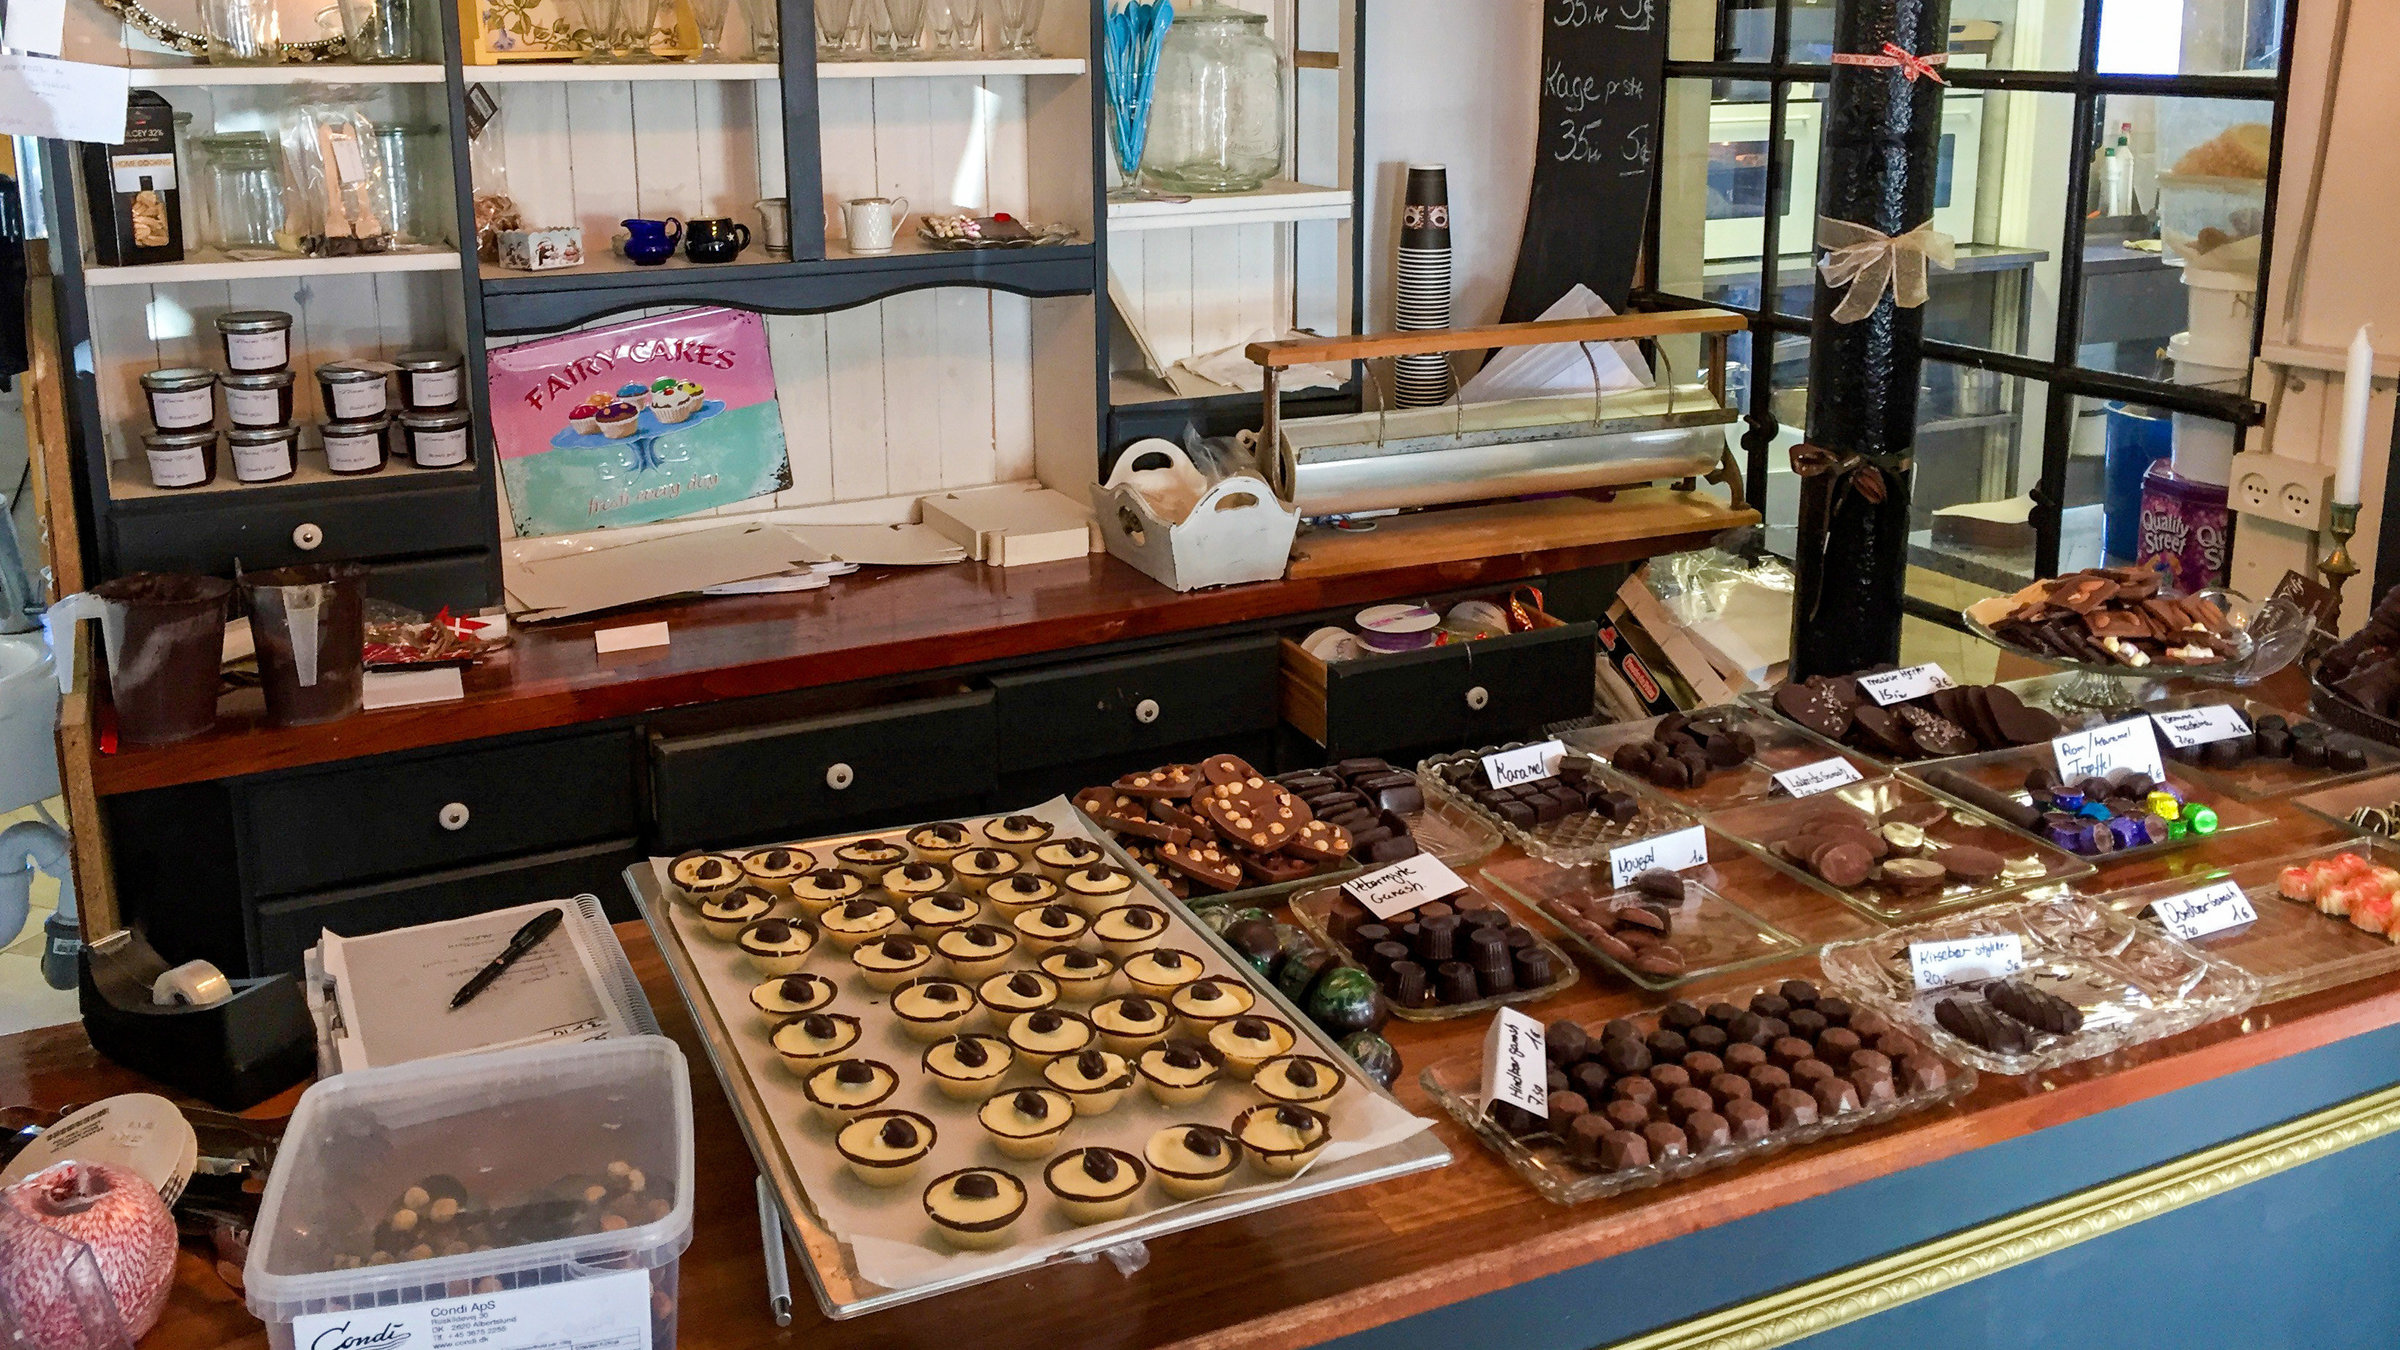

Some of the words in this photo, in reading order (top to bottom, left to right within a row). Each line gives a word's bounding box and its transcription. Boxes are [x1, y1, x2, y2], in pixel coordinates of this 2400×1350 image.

[1544, 56, 1600, 112] Kage
[524, 345, 620, 411] FAIRY
[630, 337, 737, 370] CAKES
[587, 489, 630, 516] fresh
[635, 480, 681, 503] every
[686, 472, 720, 492] day
[2143, 510, 2190, 539] Quality
[2144, 531, 2186, 555] Street
[1494, 751, 1547, 784] Karamel
[430, 1305, 468, 1317] Condi
[471, 1300, 496, 1313] ApS
[311, 1320, 405, 1350] Condi
